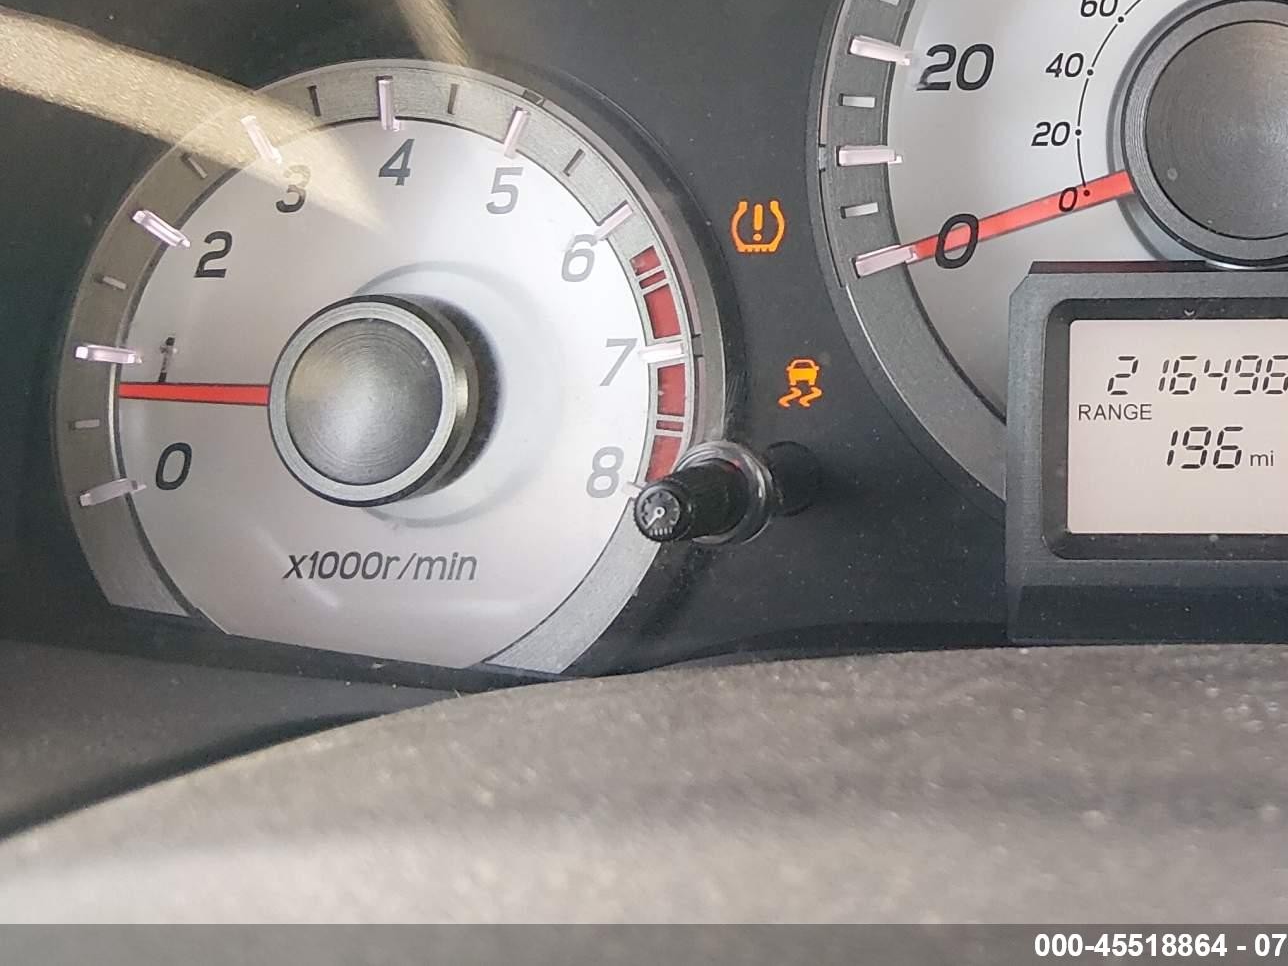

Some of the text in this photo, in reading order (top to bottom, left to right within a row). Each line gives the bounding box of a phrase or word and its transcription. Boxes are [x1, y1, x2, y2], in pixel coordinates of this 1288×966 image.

[917, 44, 995, 91] 20
[1045, 52, 1084, 78] 40
[1031, 122, 1070, 147] 20
[378, 138, 415, 186] 4
[276, 164, 312, 213] 3
[485, 166, 524, 215] 5
[1057, 187, 1078, 213] 0
[194, 231, 233, 279] 2
[561, 234, 598, 283] 6
[934, 213, 979, 270] 0
[599, 338, 637, 387] 7
[1078, 403, 1153, 421] RANGE
[156, 442, 193, 491] 0
[1166, 426, 1274, 470] 196 mi
[586, 447, 625, 499] 8
[281, 550, 477, 581] x1000r/min
